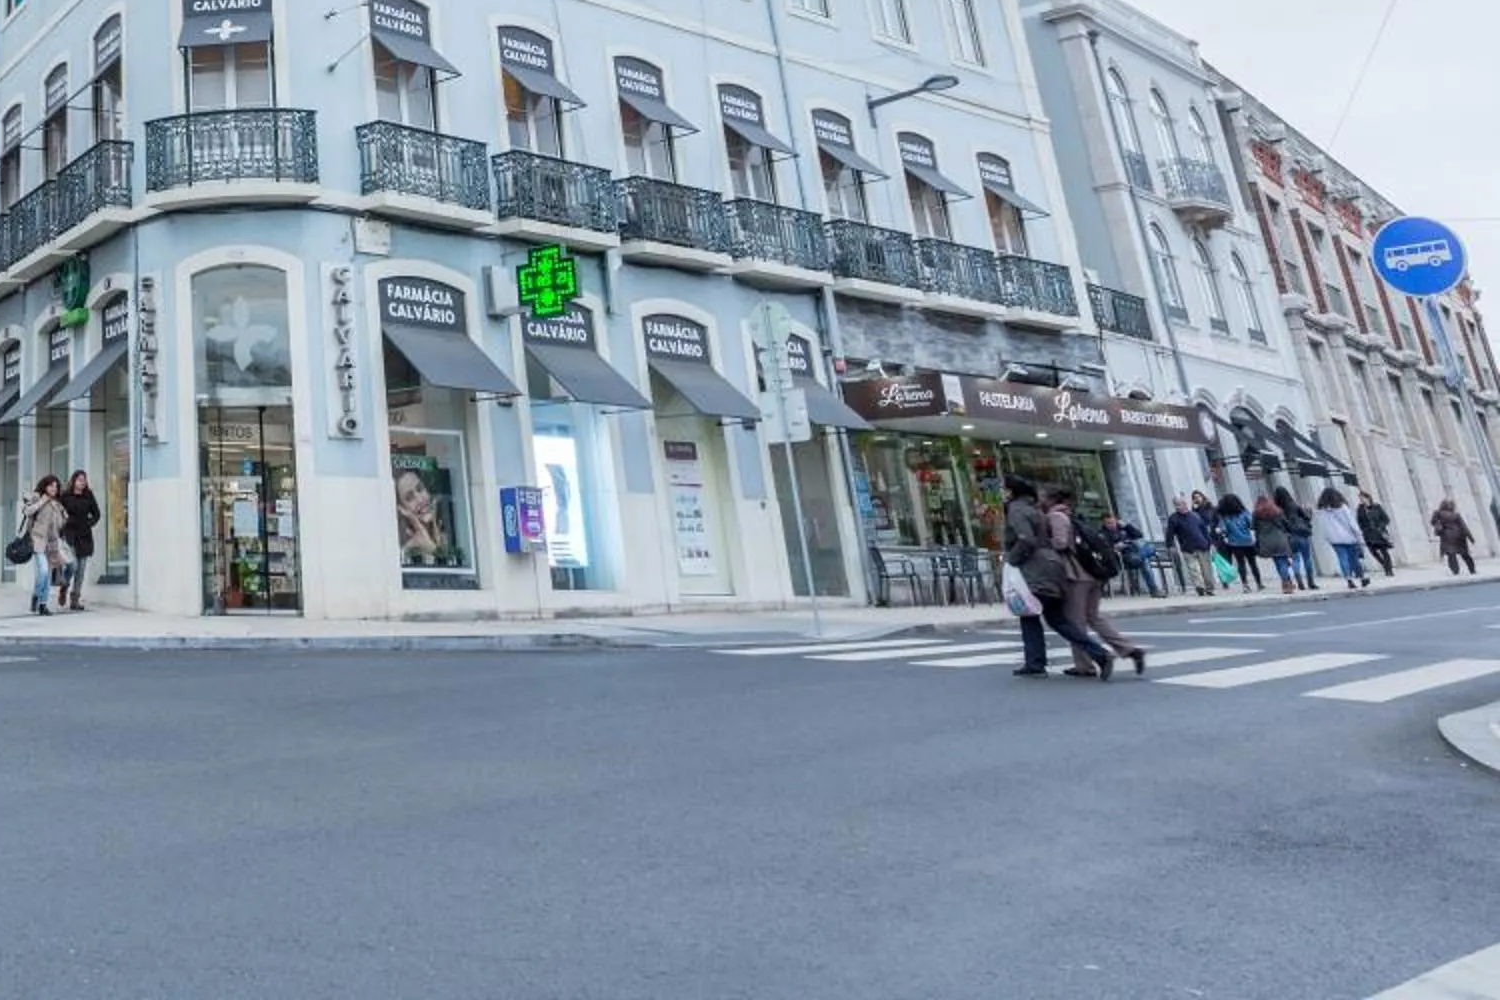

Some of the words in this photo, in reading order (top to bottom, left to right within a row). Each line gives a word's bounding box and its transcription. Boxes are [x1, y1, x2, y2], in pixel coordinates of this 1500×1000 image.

[373, 3, 423, 24] FARMÁCIA
[375, 15, 424, 37] CALVÁRIO
[387, 283, 453, 307] FARMÁCIA
[388, 302, 456, 325] CALVÁRIO
[527, 322, 587, 342] CALVÁRIO
[645, 321, 700, 340] FARMÁCIA
[649, 338, 703, 358] CALVÁRIO
